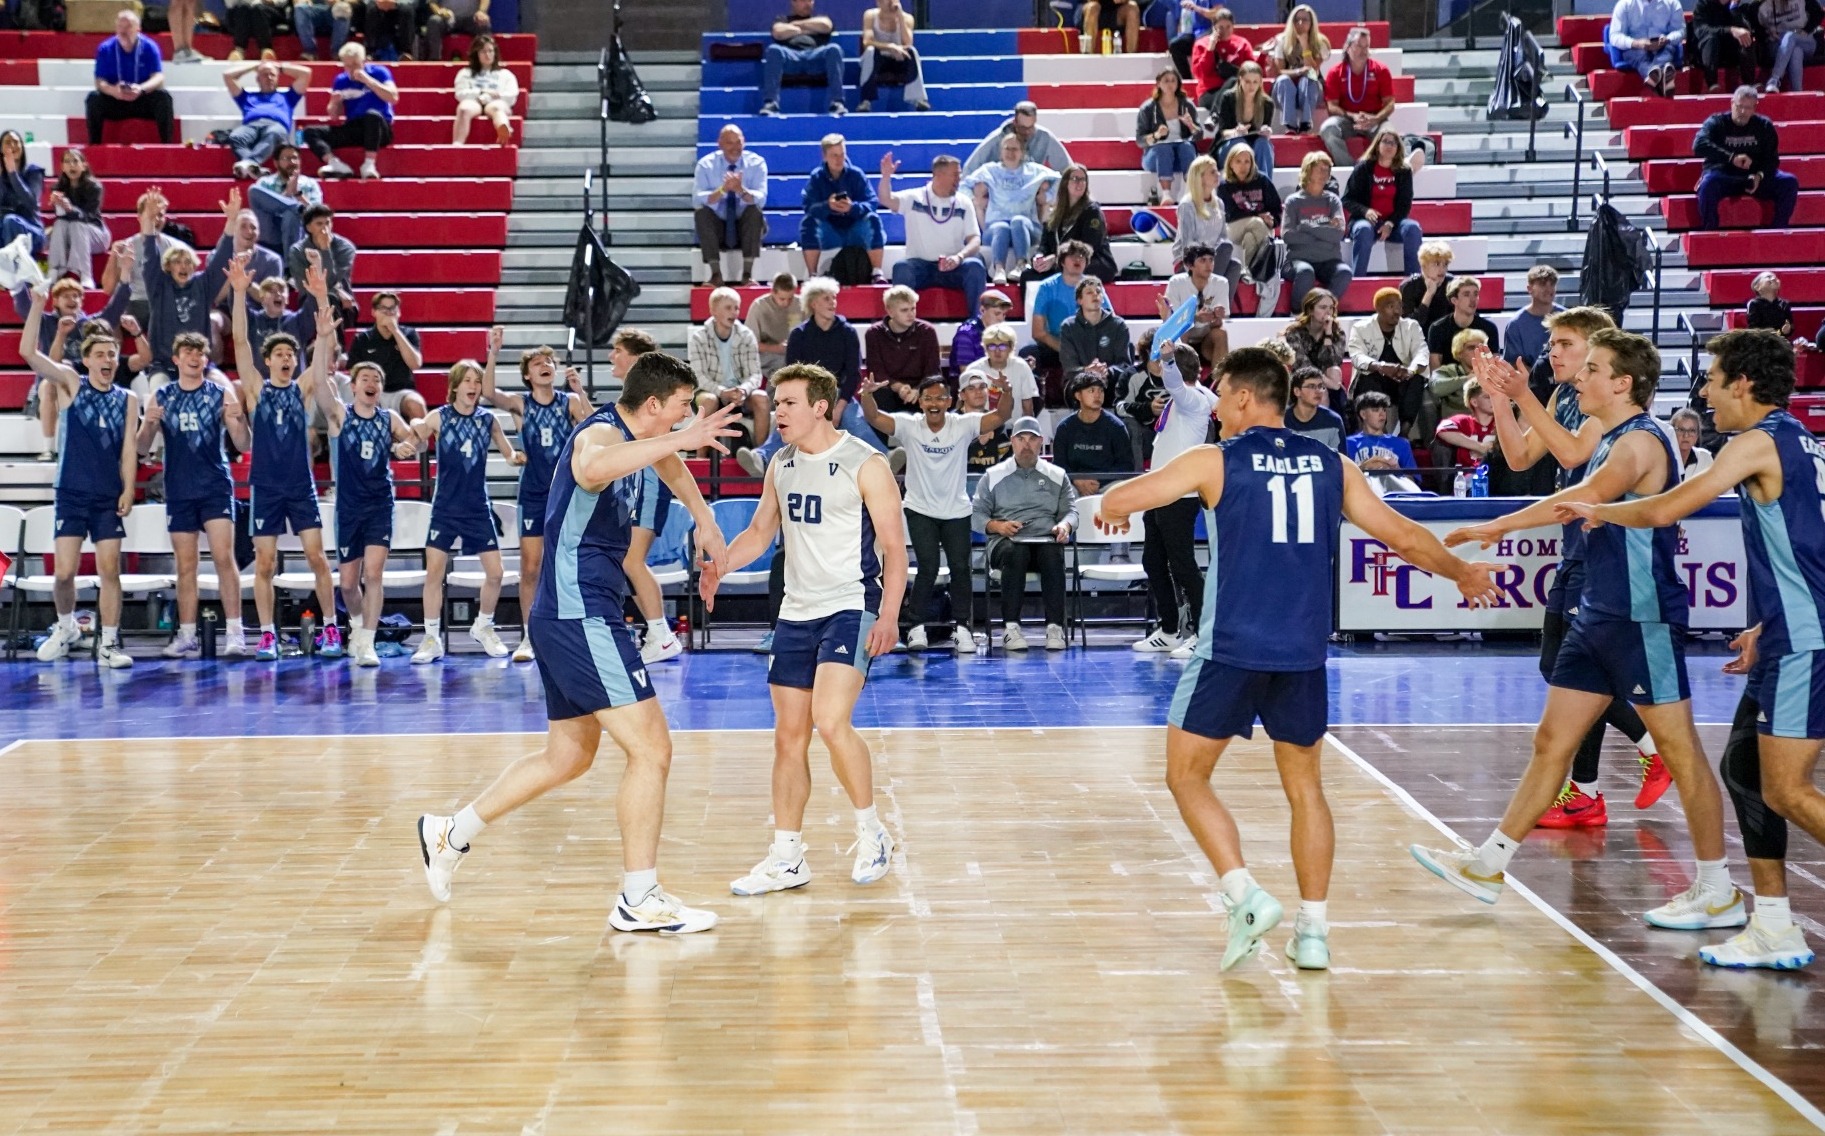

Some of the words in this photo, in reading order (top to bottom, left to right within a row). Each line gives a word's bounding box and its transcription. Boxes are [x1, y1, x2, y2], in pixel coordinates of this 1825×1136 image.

[179, 413, 199, 431] 25
[276, 409, 283, 425] 1
[540, 428, 553, 447] 8
[360, 440, 374, 460] 6
[460, 439, 473, 458] 4
[828, 463, 839, 476] V
[787, 493, 822, 524] 20
[1267, 474, 1315, 543] 11
[255, 519, 265, 530] V
[524, 519, 534, 531] V
[430, 530, 440, 541] V
[340, 547, 350, 558] V
[1496, 539, 1561, 557] HOM
[632, 669, 649, 688] V
